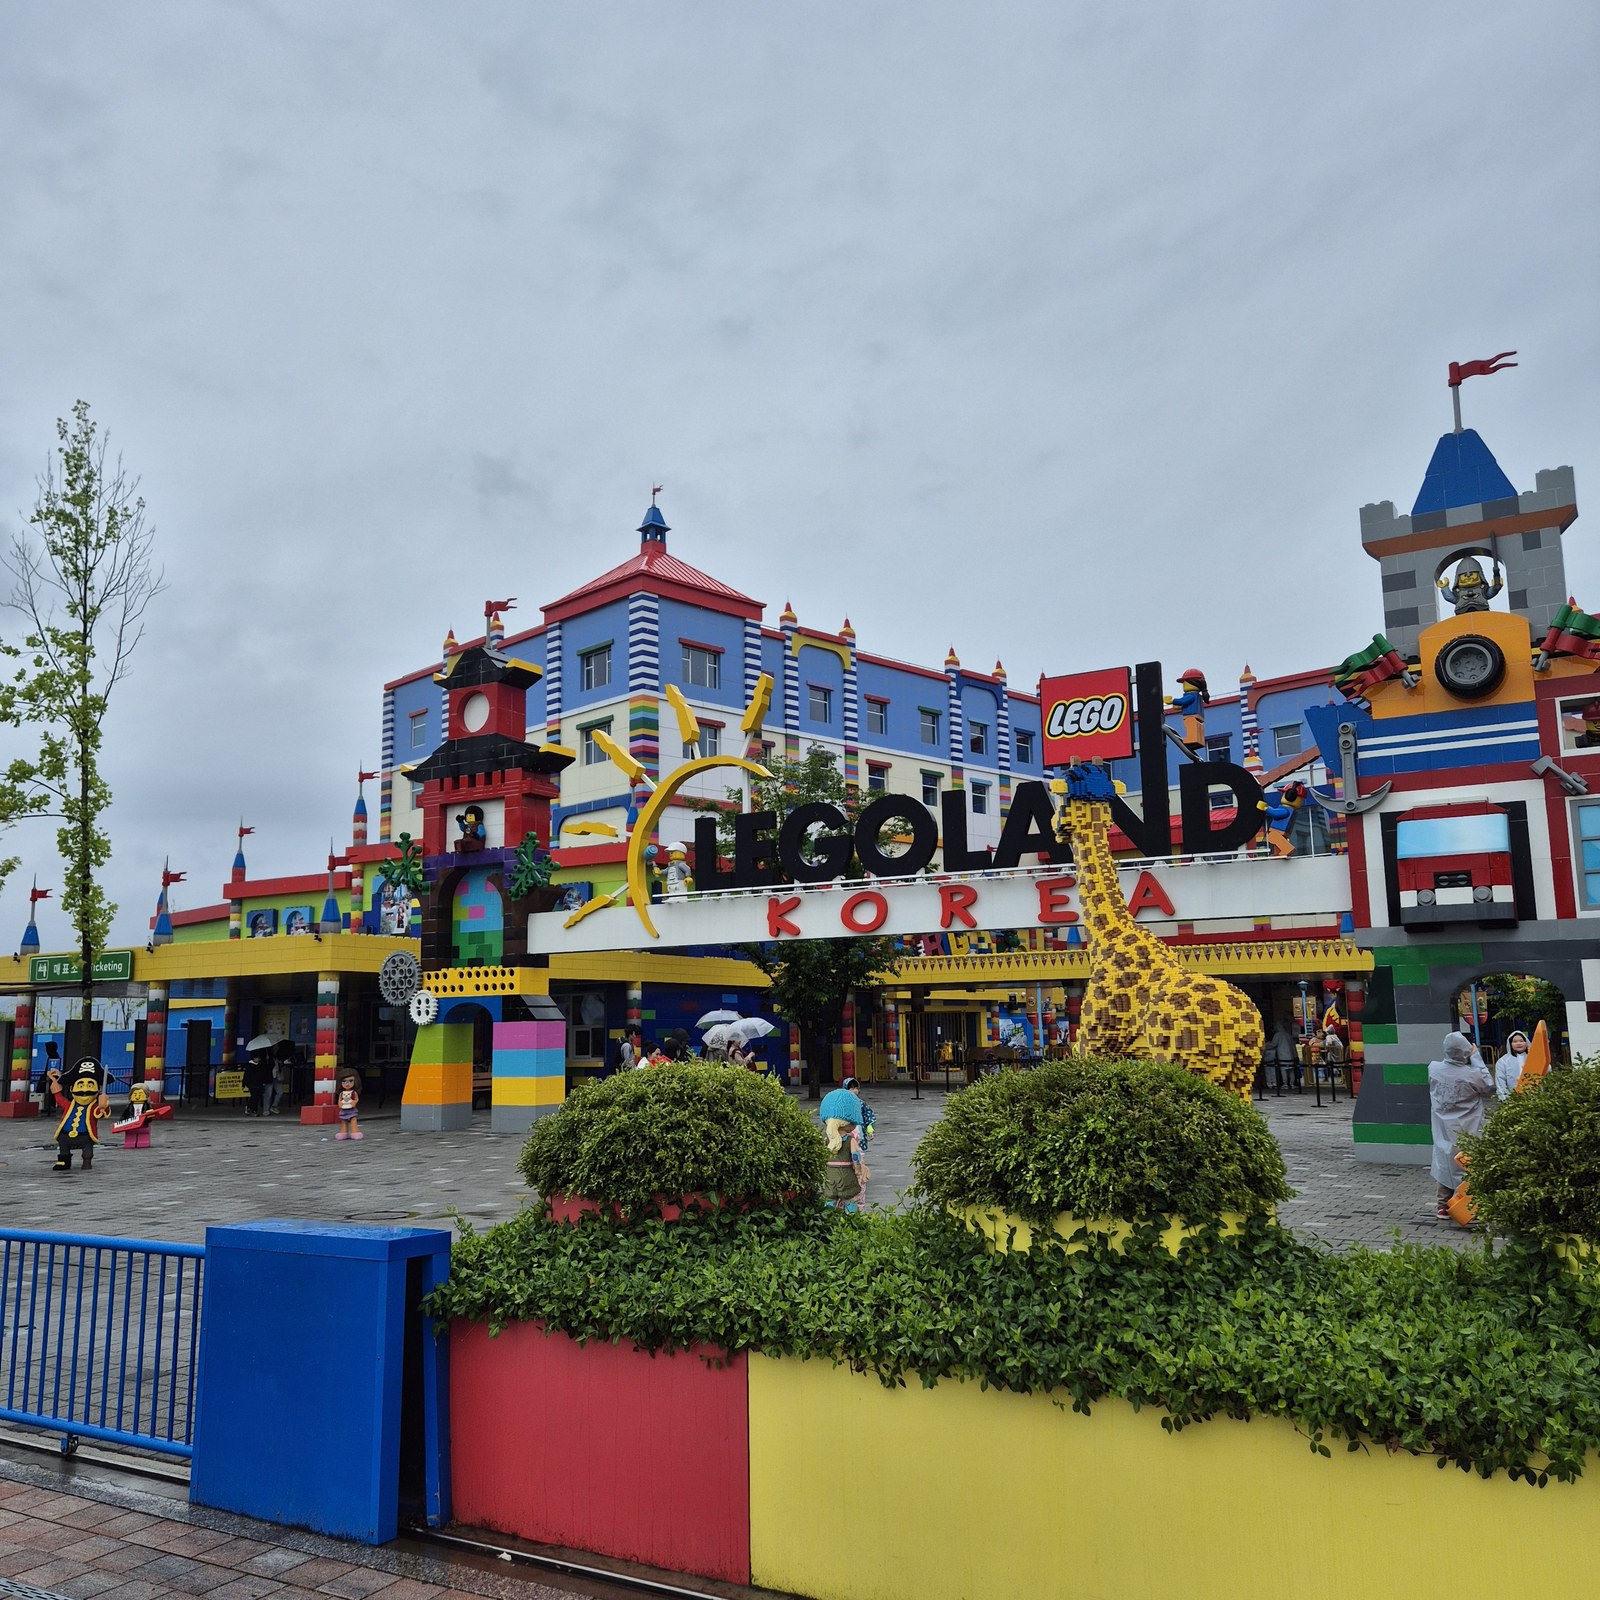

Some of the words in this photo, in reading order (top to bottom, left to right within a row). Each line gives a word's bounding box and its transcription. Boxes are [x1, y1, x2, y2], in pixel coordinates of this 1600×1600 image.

[1047, 693, 1126, 739] LEGO
[694, 661, 1265, 892] LEGOLAND
[767, 871, 1176, 938] KOREA
[53, 963, 78, 975] 매표소
